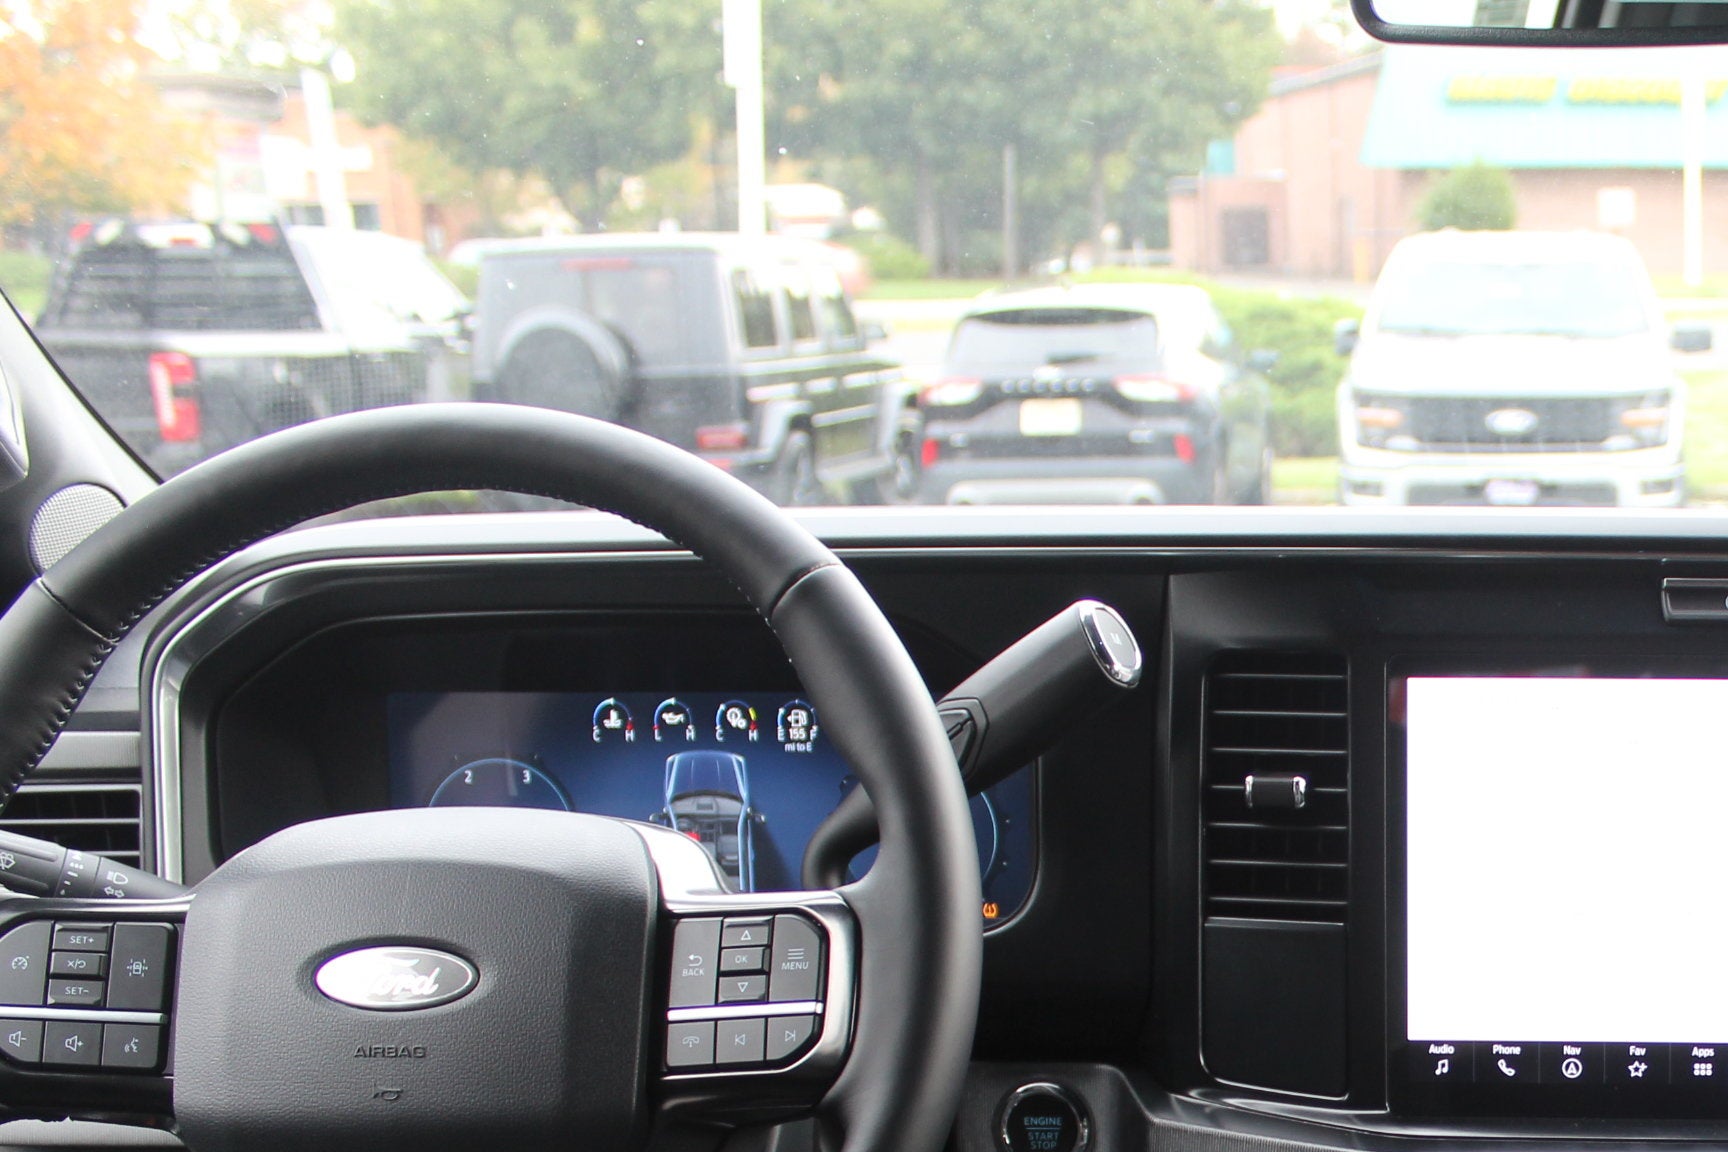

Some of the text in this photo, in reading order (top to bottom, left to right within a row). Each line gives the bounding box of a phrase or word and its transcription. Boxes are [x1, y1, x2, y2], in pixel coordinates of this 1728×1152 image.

[592, 729, 601, 742] C
[625, 729, 635, 742] H
[654, 729, 662, 742] L
[686, 728, 696, 742] H
[715, 729, 724, 742] C
[749, 729, 759, 742] H
[777, 729, 785, 741] E
[789, 728, 806, 740] 155
[464, 769, 473, 785] 2
[522, 769, 532, 785] 3
[734, 954, 748, 964] OK
[682, 967, 705, 977] BACK
[781, 961, 809, 971] MENU
[354, 1046, 427, 1059] AIRBAG
[1428, 1044, 1455, 1055] Audio
[1492, 1044, 1521, 1055] Phone
[1563, 1045, 1581, 1056] Nav
[1629, 1046, 1646, 1056] Fav
[1691, 1046, 1715, 1058] Apps
[1024, 1116, 1063, 1126] ENGINE
[1028, 1131, 1059, 1141] START
[1030, 1141, 1057, 1150] STOP
